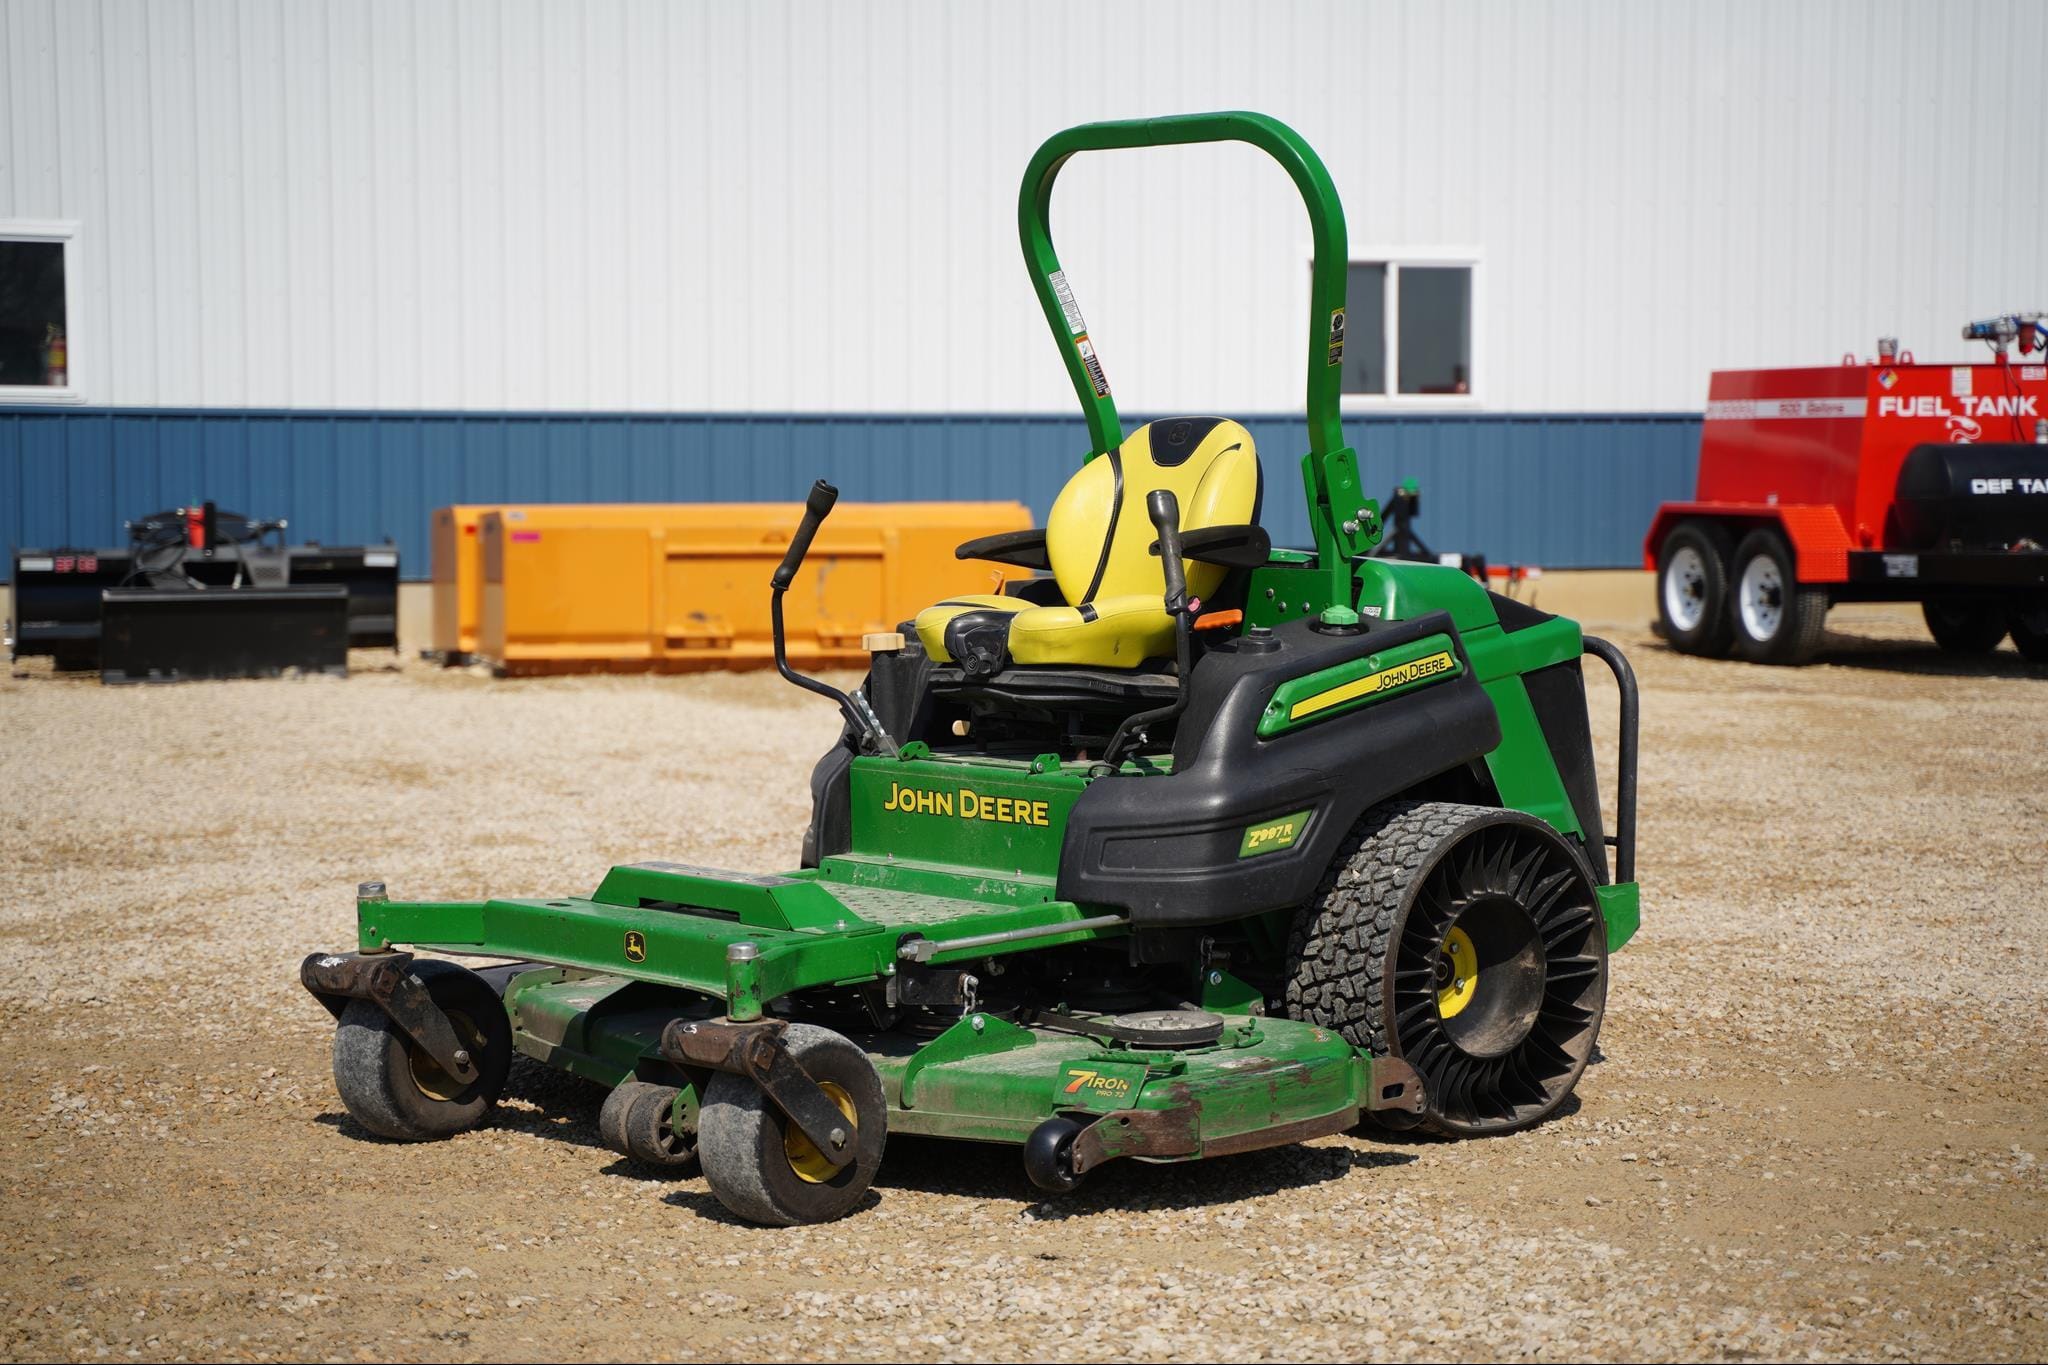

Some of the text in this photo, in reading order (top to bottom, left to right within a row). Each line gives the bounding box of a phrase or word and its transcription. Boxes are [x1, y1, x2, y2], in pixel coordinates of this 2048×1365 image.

[1879, 395, 2038, 418] FUEL TANK
[1971, 478, 2048, 494] DEF TA
[1377, 657, 1446, 691] JOHN DEERE
[884, 781, 1049, 827] JOHN DEERE
